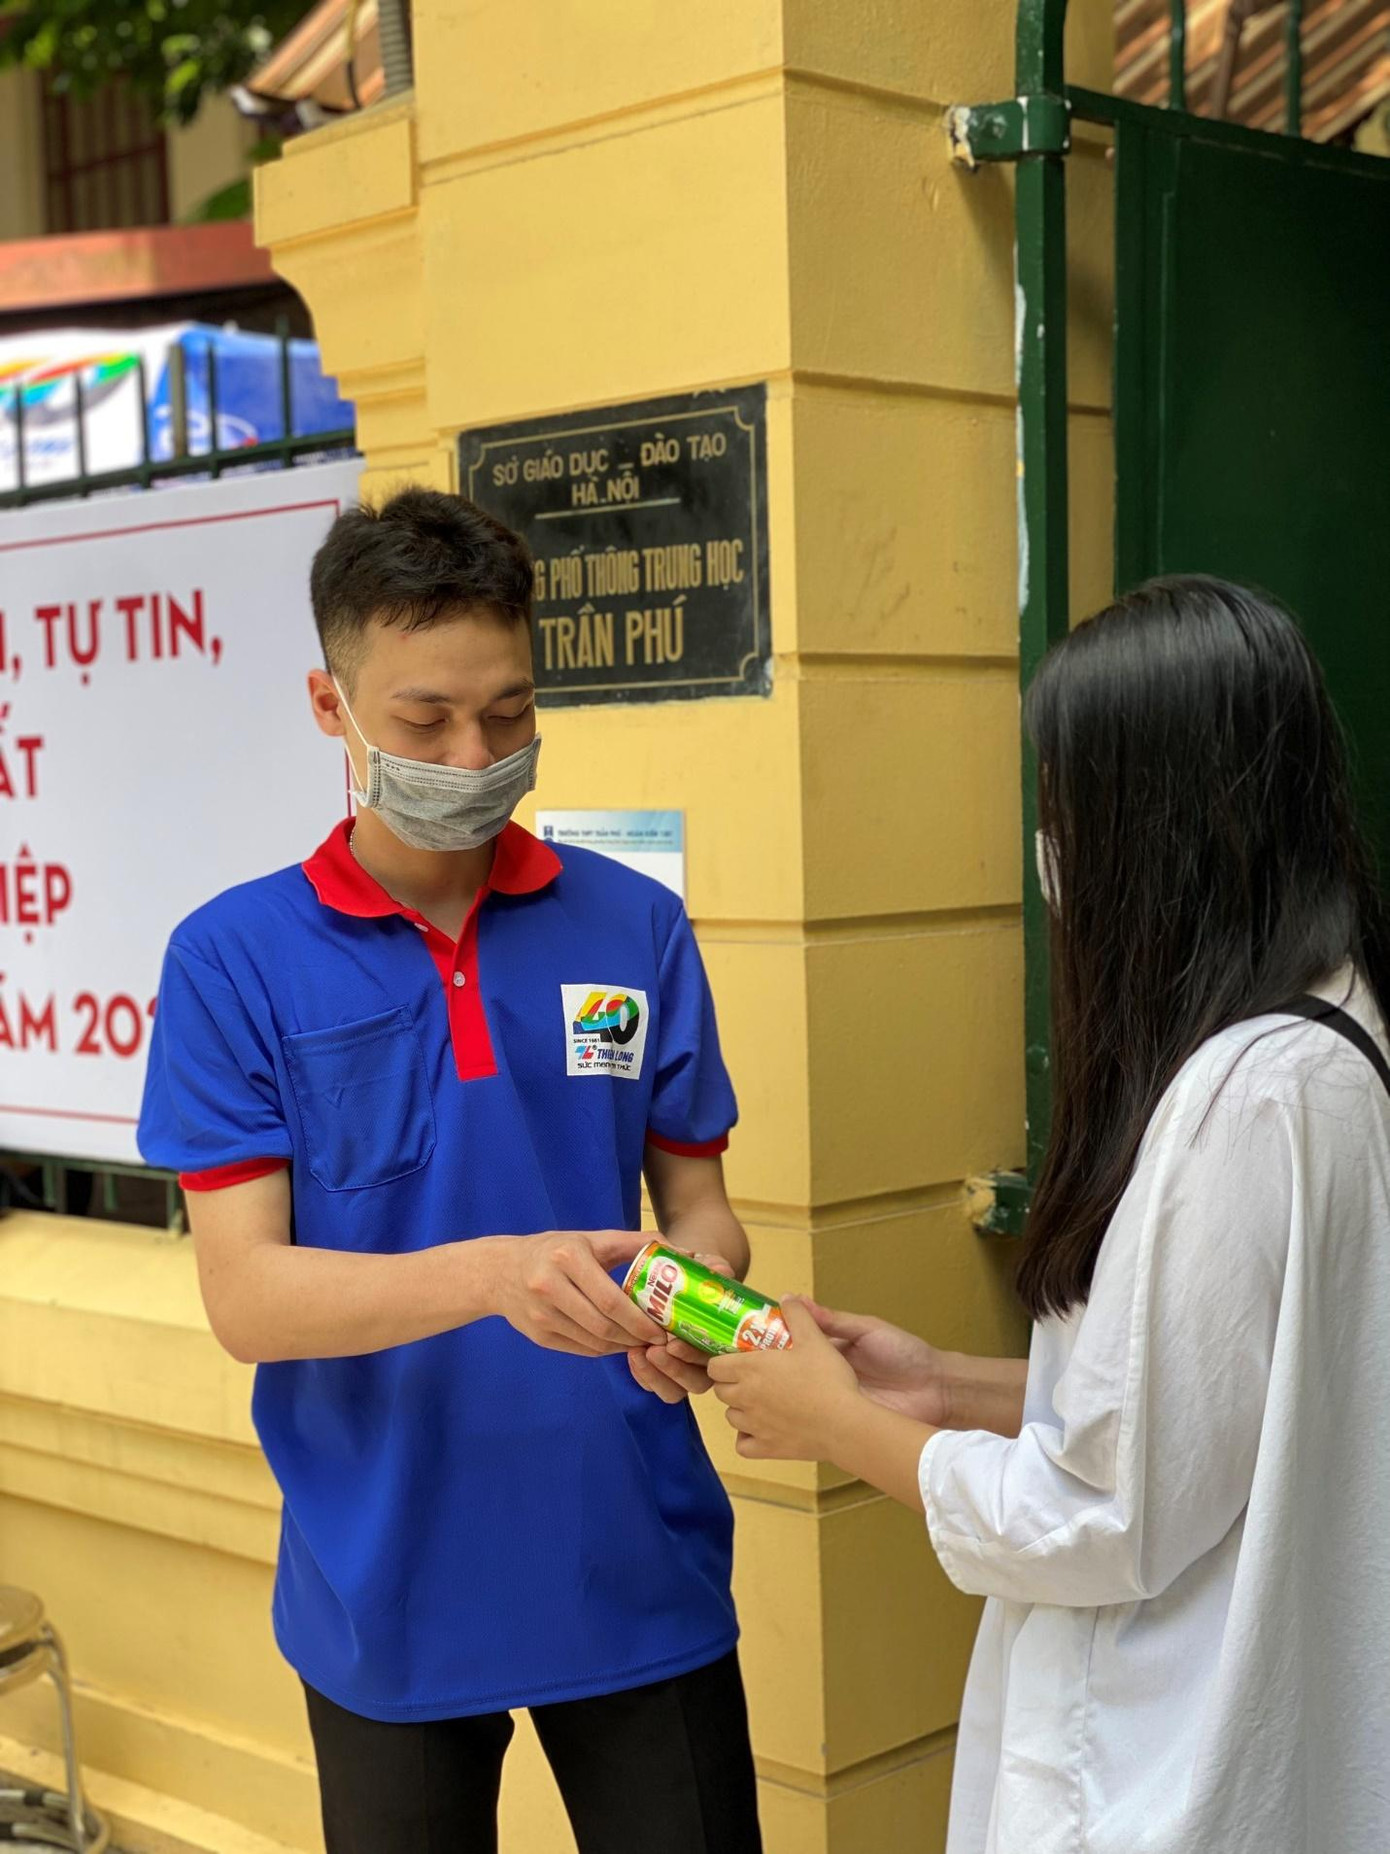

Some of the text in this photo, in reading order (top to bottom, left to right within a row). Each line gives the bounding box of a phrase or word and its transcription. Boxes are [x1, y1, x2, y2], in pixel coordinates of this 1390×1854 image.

[640, 432, 680, 467] ĐÀO
[686, 432, 727, 462] TẠO
[585, 545, 640, 597] THÔNG
[642, 543, 702, 592] TRUNG
[706, 538, 744, 590] HỌC
[34, 596, 103, 687] TỰ
[114, 588, 222, 667] TIN,
[625, 594, 687, 666] PHÚ
[73, 989, 158, 1059] 20
[647, 1265, 678, 1322] MILO
